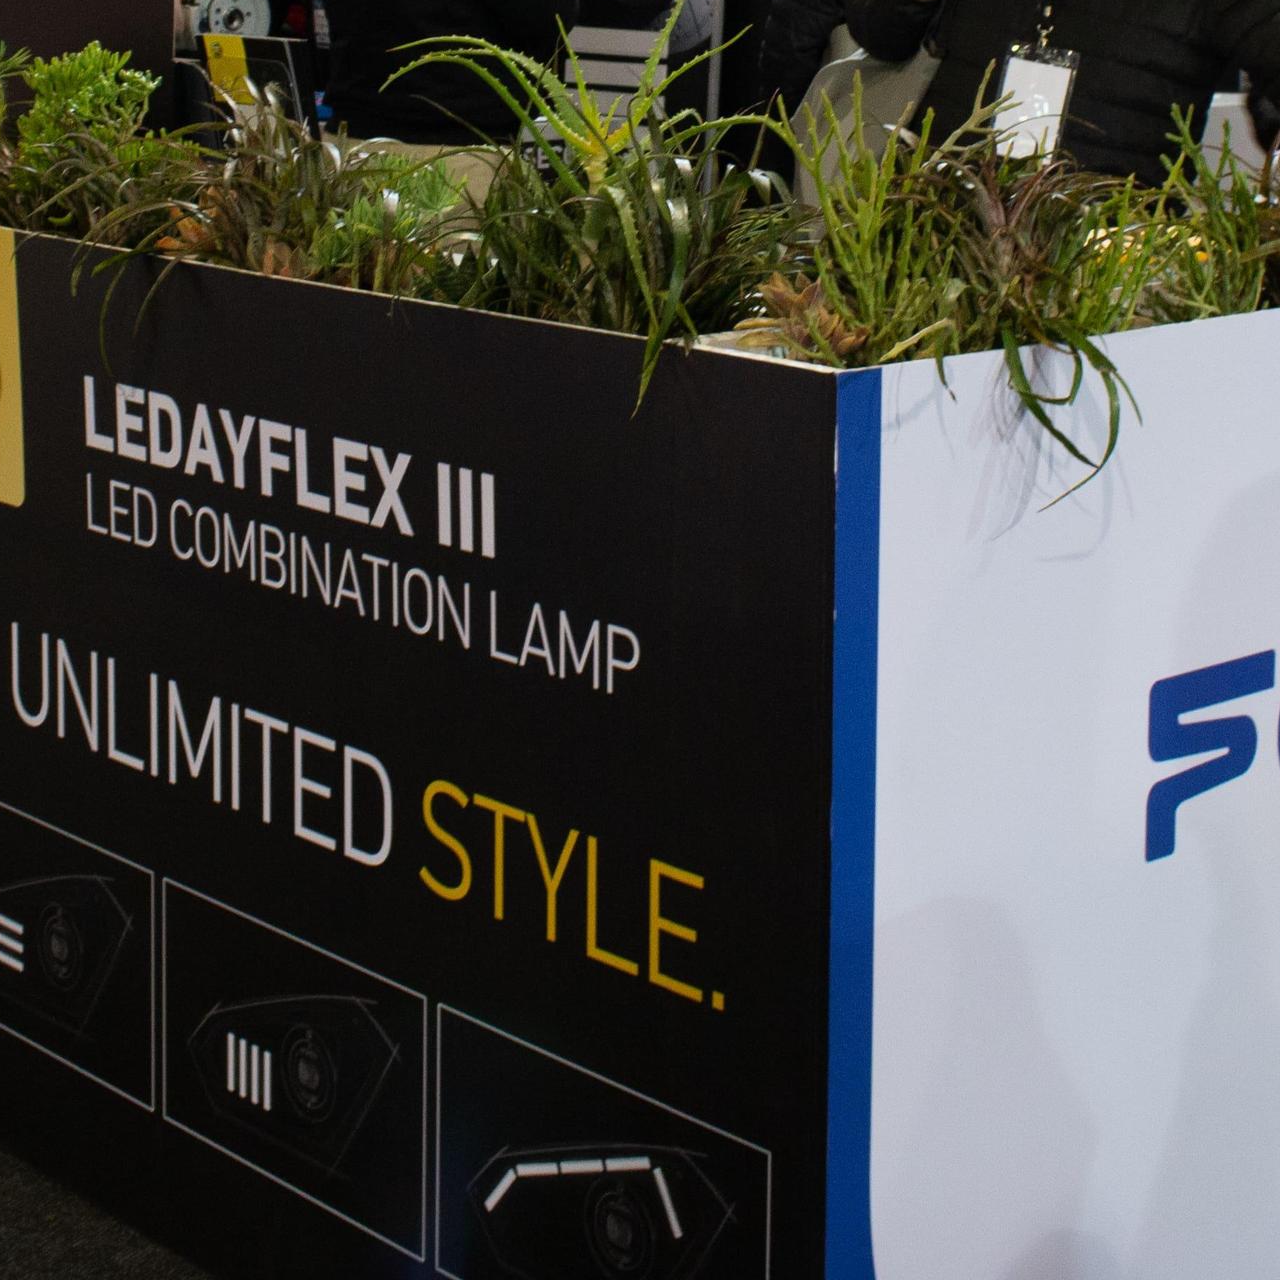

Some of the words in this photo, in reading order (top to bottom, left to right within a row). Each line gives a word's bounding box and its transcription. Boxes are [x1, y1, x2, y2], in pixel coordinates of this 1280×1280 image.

[83, 374, 414, 538] LEDAYFLEX
[437, 461, 496, 559] III
[85, 472, 158, 549] LED
[169, 498, 471, 651] COMBINATION
[489, 589, 641, 695] LAMP
[10, 621, 394, 868] UNLIMITED
[418, 779, 725, 1011] STYLE.
